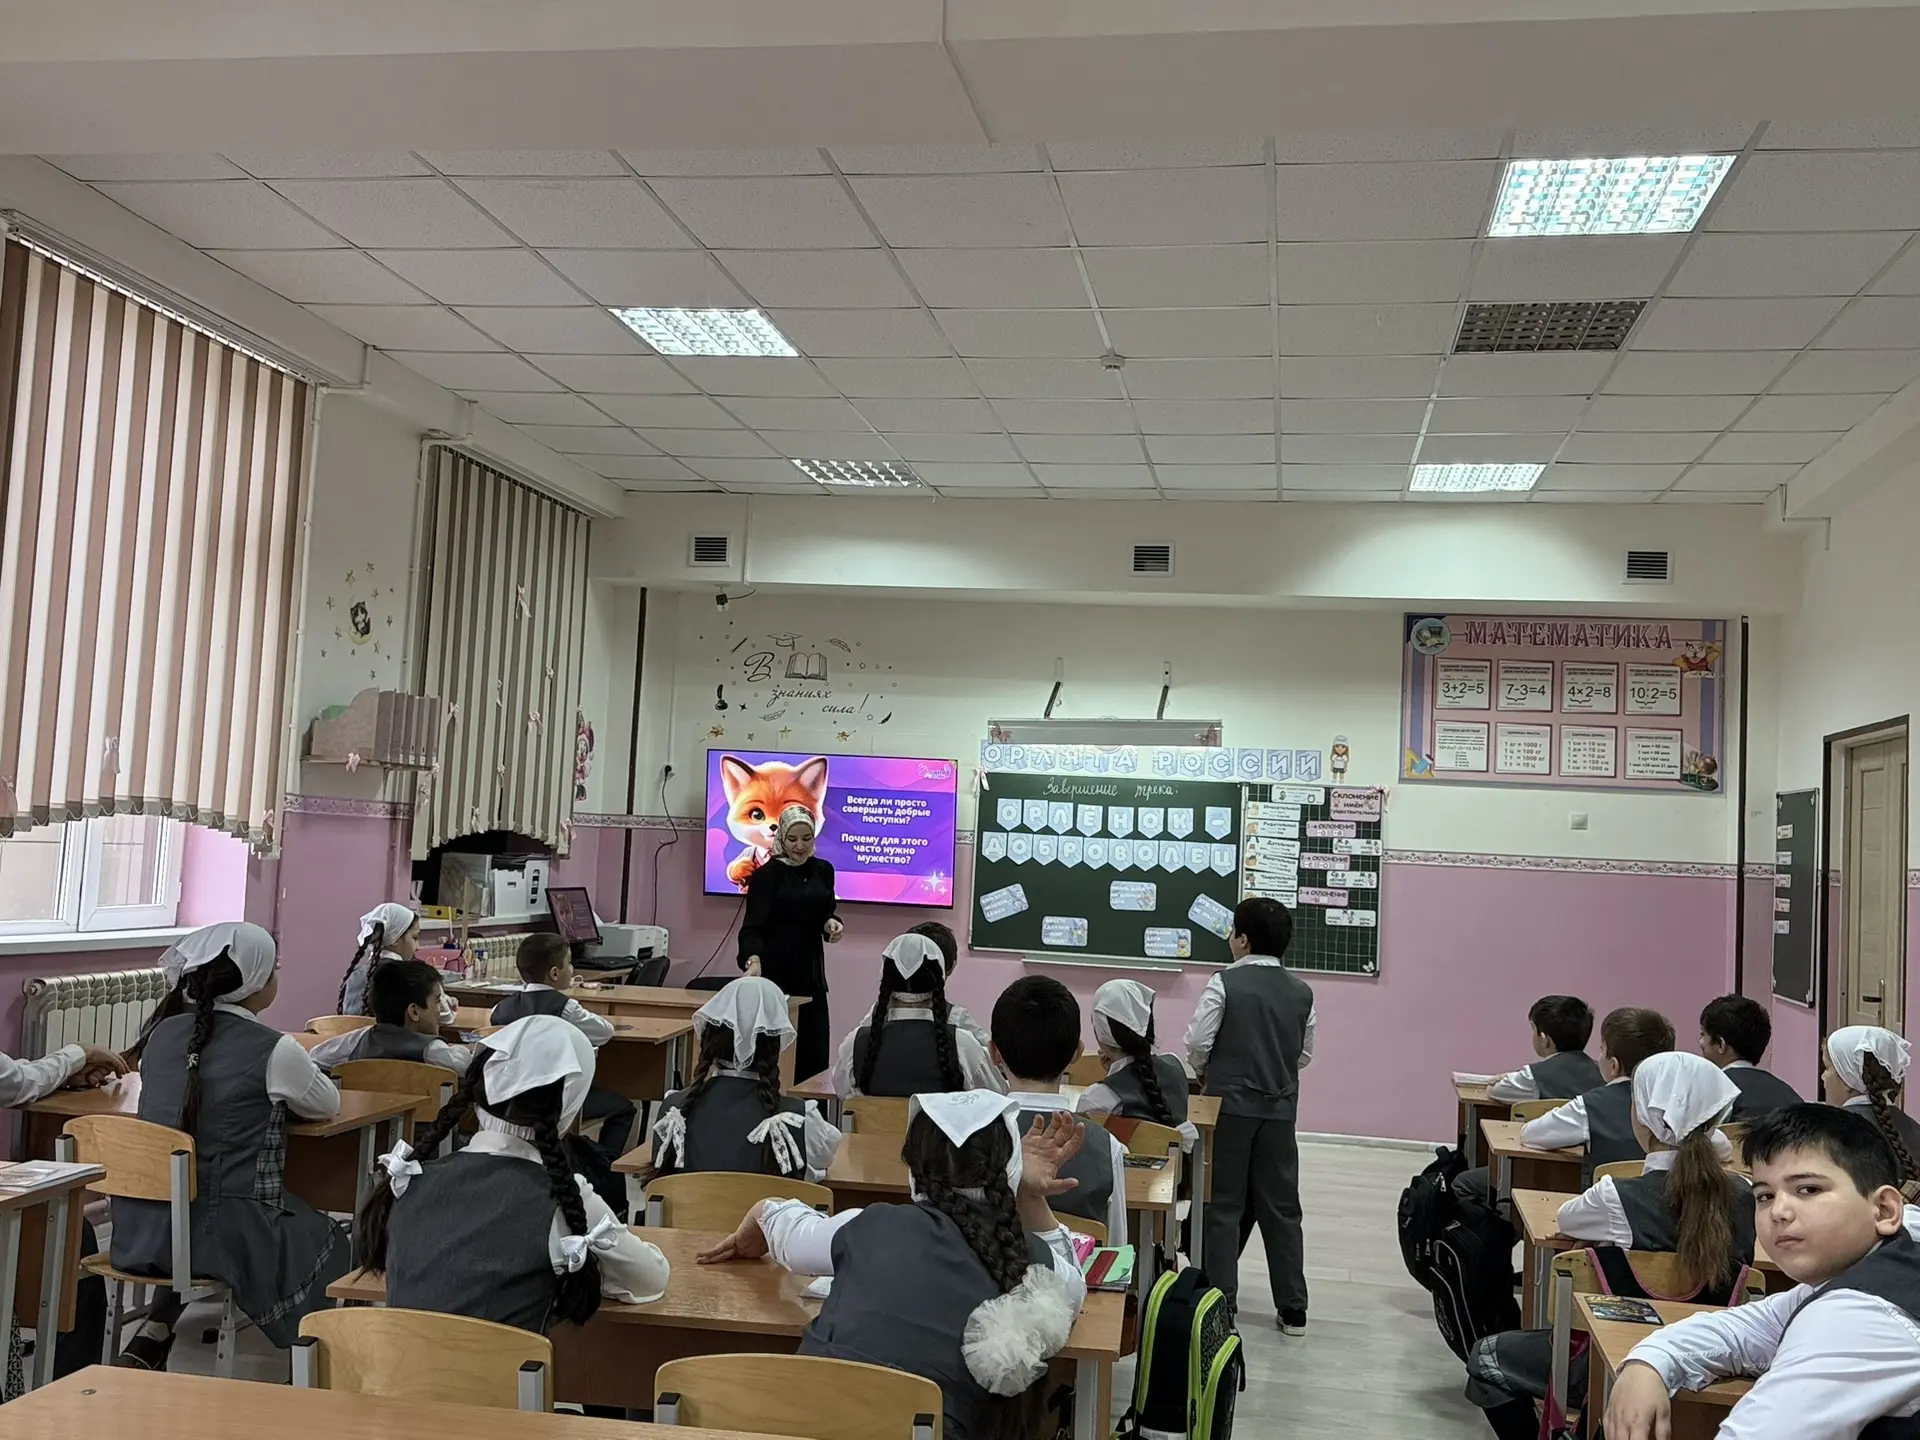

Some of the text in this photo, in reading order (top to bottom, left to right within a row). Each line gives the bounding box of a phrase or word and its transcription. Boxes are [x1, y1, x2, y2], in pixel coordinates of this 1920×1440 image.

[1465, 621, 1673, 649] МАТЕМАТИКА
[743, 651, 775, 682] В
[1442, 682, 1484, 695] 3+2=5
[1506, 684, 1546, 696] 7-3=4
[1629, 687, 1677, 700] 10:2=5
[766, 688, 832, 708] знаниях
[1158, 751, 1317, 776] РОССИИ
[1043, 776, 1119, 800] Завершение
[847, 796, 878, 806] Всегда
[894, 800, 926, 808] просто
[1332, 791, 1379, 800] Склонение
[842, 806, 931, 817] совершать добрые
[1001, 804, 1188, 830] ОРЛЁНОК
[862, 816, 910, 825] поступки?
[842, 834, 928, 846] Почему для этого
[854, 845, 915, 855] часто нужно
[984, 837, 1232, 867] ДОБРОВОЛЕЦ
[857, 855, 911, 864] мужество?
